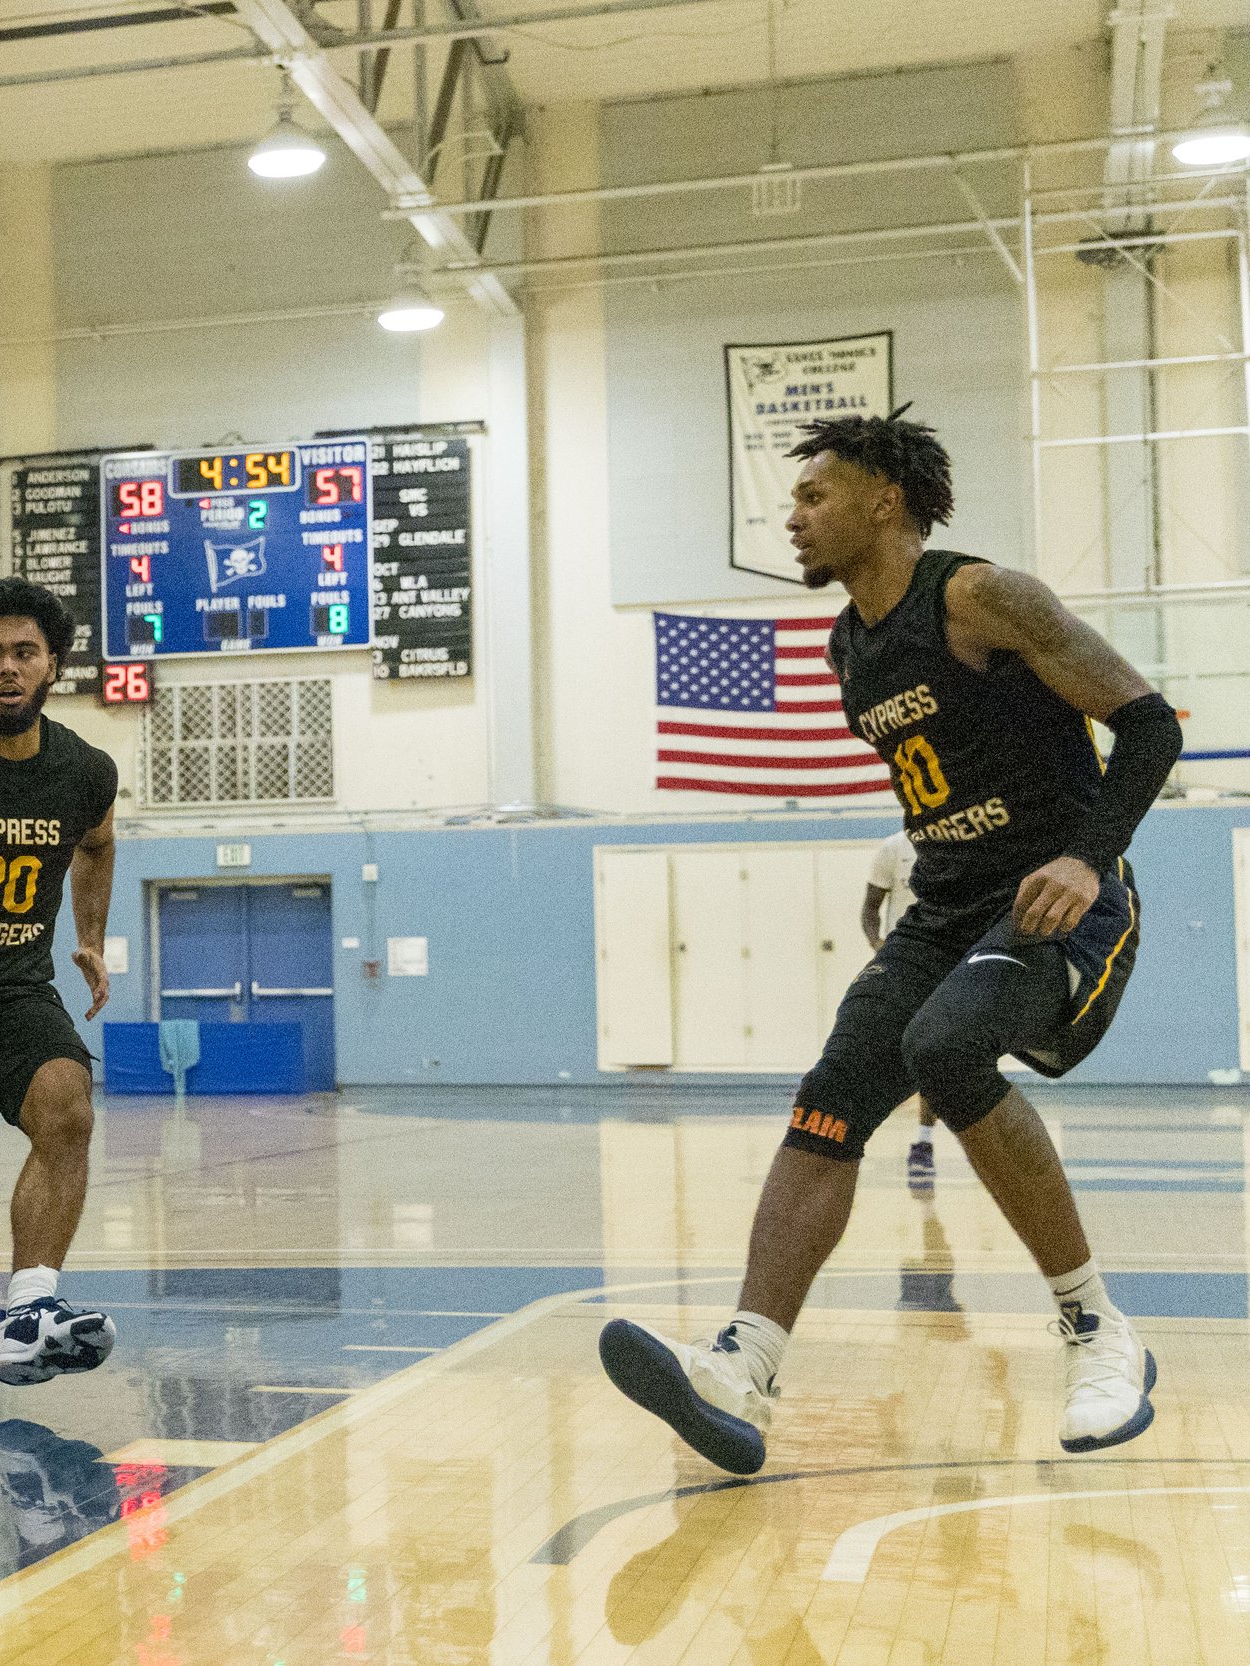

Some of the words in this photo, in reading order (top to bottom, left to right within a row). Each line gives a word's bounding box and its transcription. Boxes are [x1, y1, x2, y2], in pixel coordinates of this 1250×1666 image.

[784, 381, 835, 396] MEN'S
[755, 395, 868, 415] BASKETBALL
[301, 444, 365, 465] VISITOR
[392, 441, 448, 457] HAISLIP
[26, 469, 90, 484] ANDERSON
[200, 451, 290, 491] 4:54
[25, 485, 81, 500] GOODMAN
[316, 466, 362, 505] 57
[118, 481, 163, 517] 58
[249, 499, 267, 529] 2
[300, 508, 341, 524] BONUS
[27, 527, 76, 542] JIMENEZ
[131, 520, 170, 535] BONUS
[301, 529, 363, 545] TIMEOUTS
[398, 529, 467, 546] GLENDALE
[110, 541, 169, 557] TIMEOUTS
[323, 544, 343, 572] 4
[130, 556, 150, 583] 4
[374, 561, 400, 576] OCT
[318, 572, 348, 587] LEFT
[126, 583, 153, 597] LEFT
[310, 590, 350, 606] FOULS
[390, 590, 417, 605] ANT
[419, 587, 470, 602] VALLEY
[126, 600, 163, 615] FOULS
[195, 596, 240, 612] PLAYER
[248, 594, 286, 609] FOULS
[329, 604, 349, 634] 8
[398, 604, 463, 619] CANYONS
[144, 613, 162, 642] 7
[374, 635, 400, 648] NOV
[400, 648, 450, 662] CITRUS
[105, 664, 149, 701] 26
[858, 683, 939, 743] CYPRESS
[894, 735, 951, 816] 10
